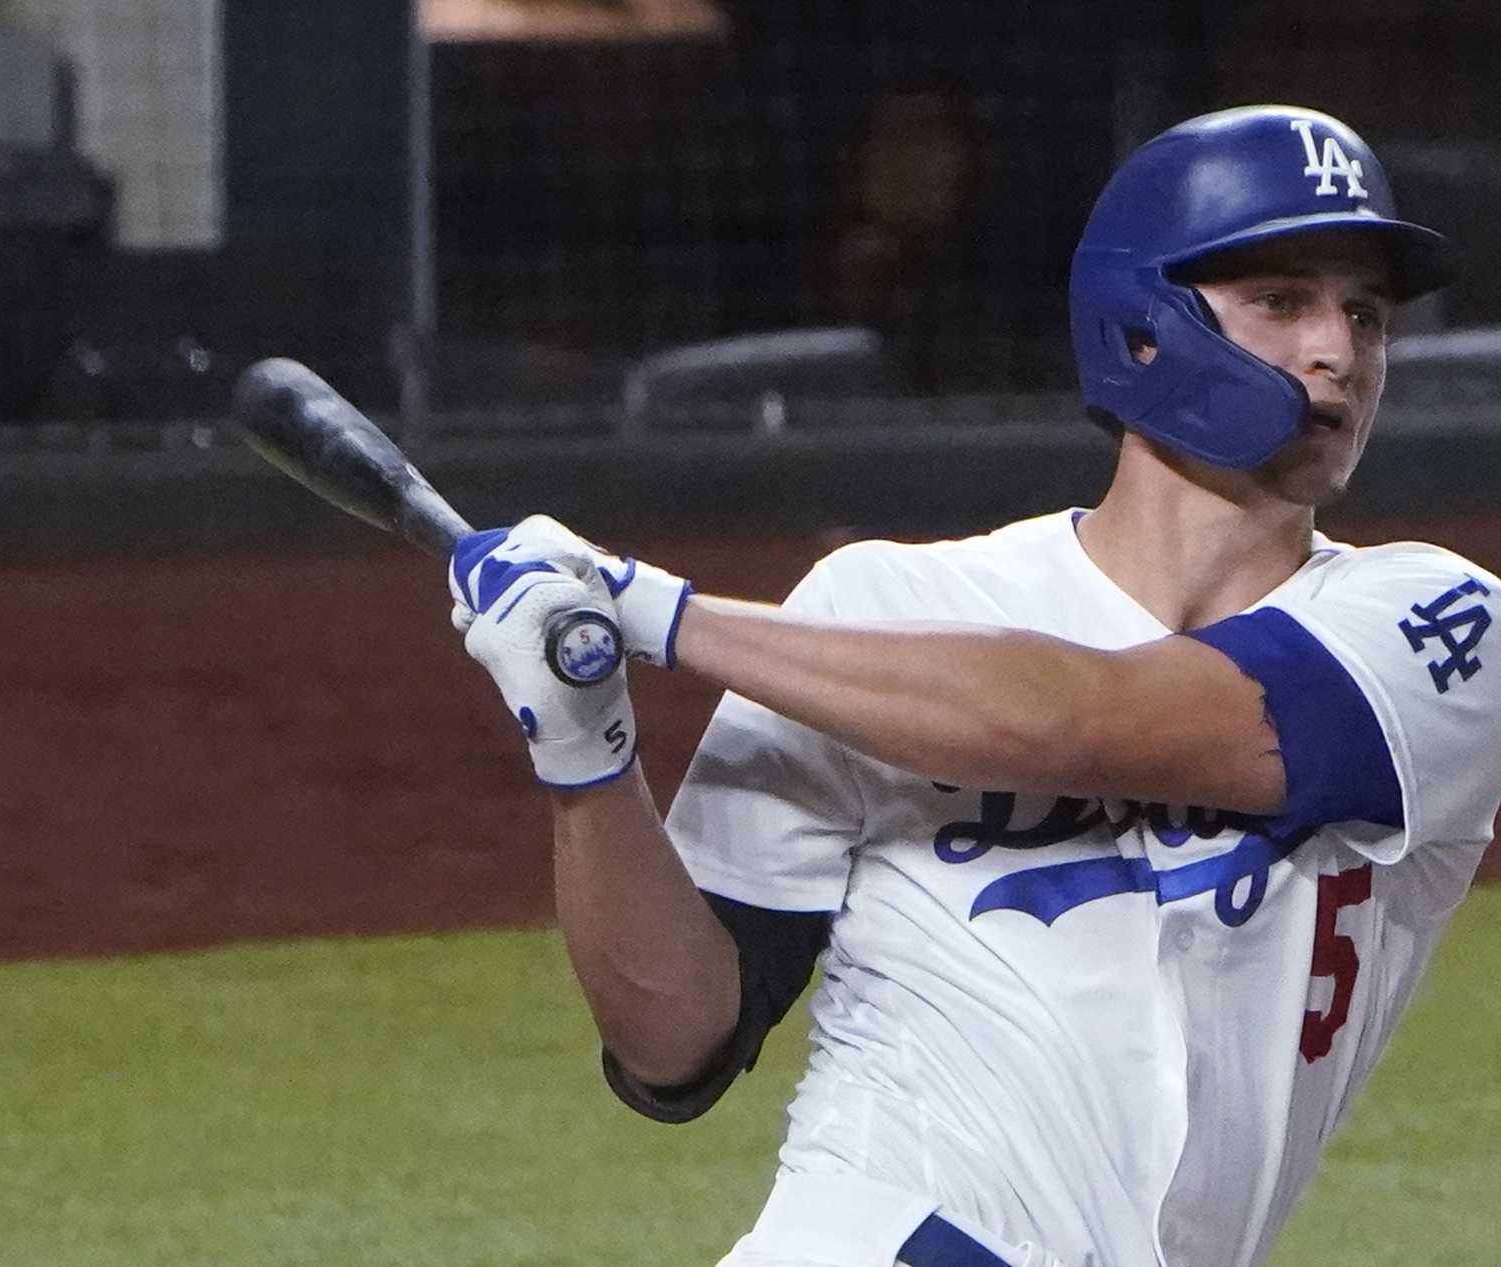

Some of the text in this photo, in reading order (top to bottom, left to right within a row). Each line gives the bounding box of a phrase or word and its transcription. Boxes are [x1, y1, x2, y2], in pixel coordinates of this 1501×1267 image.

[1290, 120, 1368, 199] LA
[1397, 572, 1492, 694] LA
[603, 719, 627, 754] 5
[1299, 862, 1373, 1064] 5
